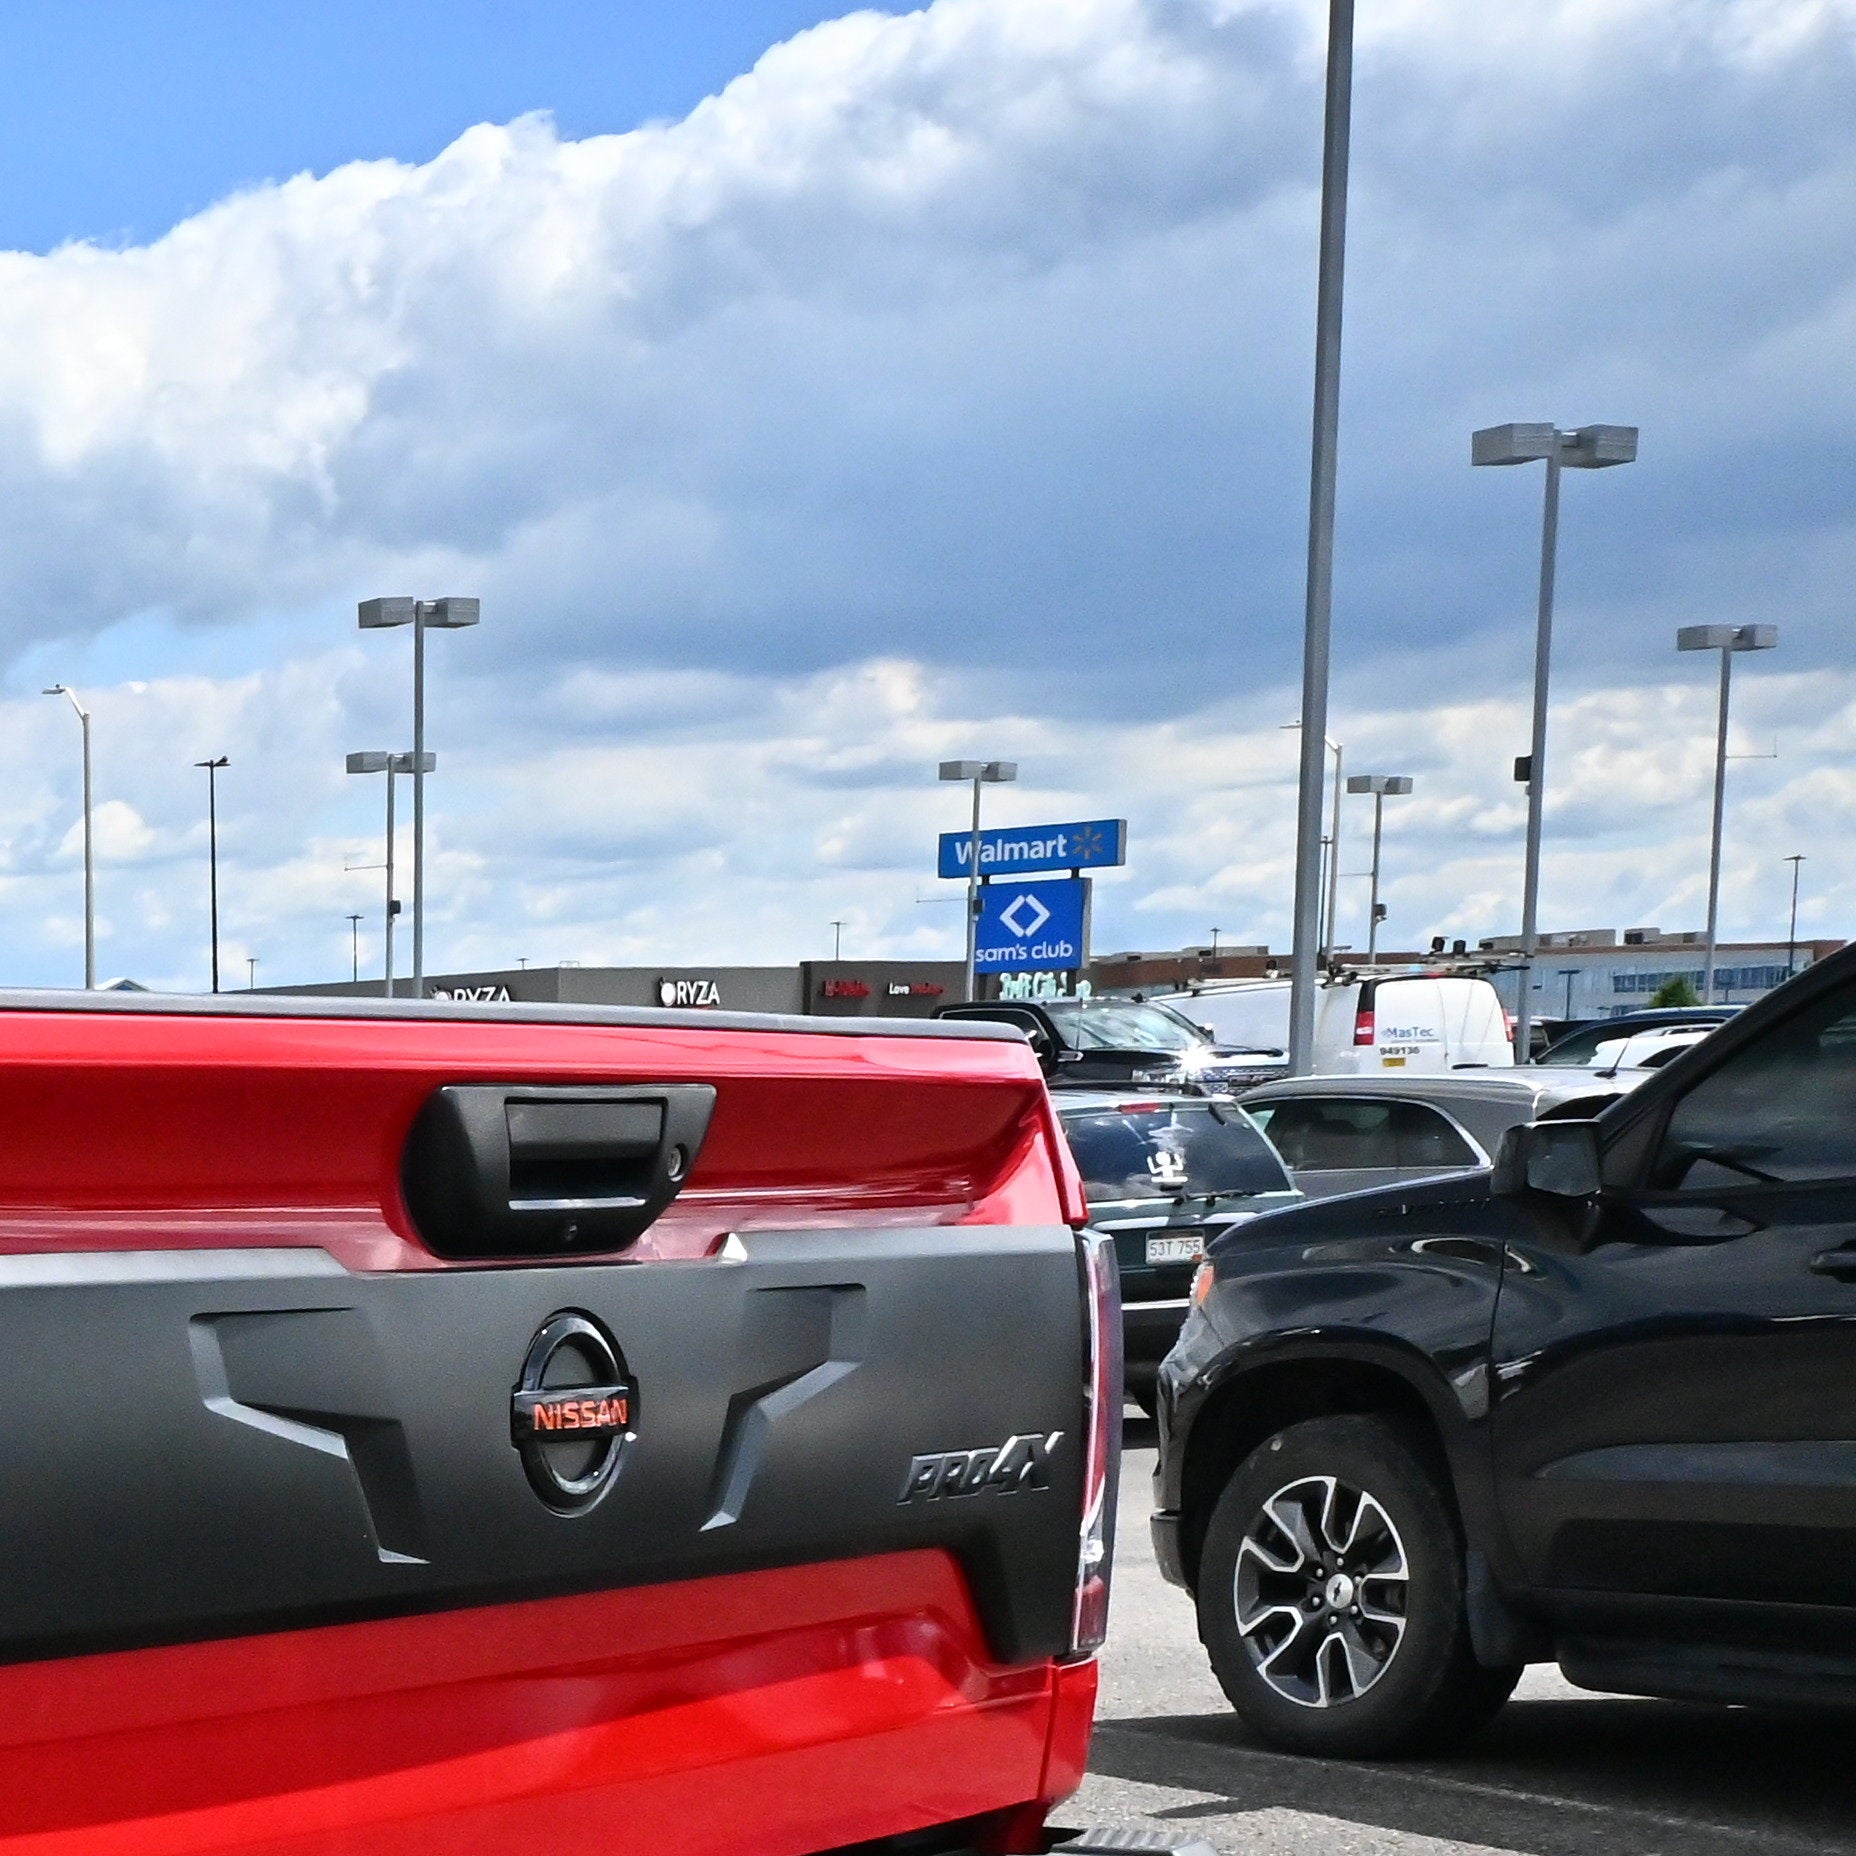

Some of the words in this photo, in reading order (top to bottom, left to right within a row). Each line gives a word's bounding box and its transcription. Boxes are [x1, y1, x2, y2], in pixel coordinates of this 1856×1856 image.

[955, 833, 1068, 865] Walmart
[975, 943, 1028, 963] sam's
[1031, 939, 1074, 960] club
[889, 982, 910, 995] Love
[1385, 1026, 1434, 1038] MasTec
[532, 1398, 628, 1431] NISSAN
